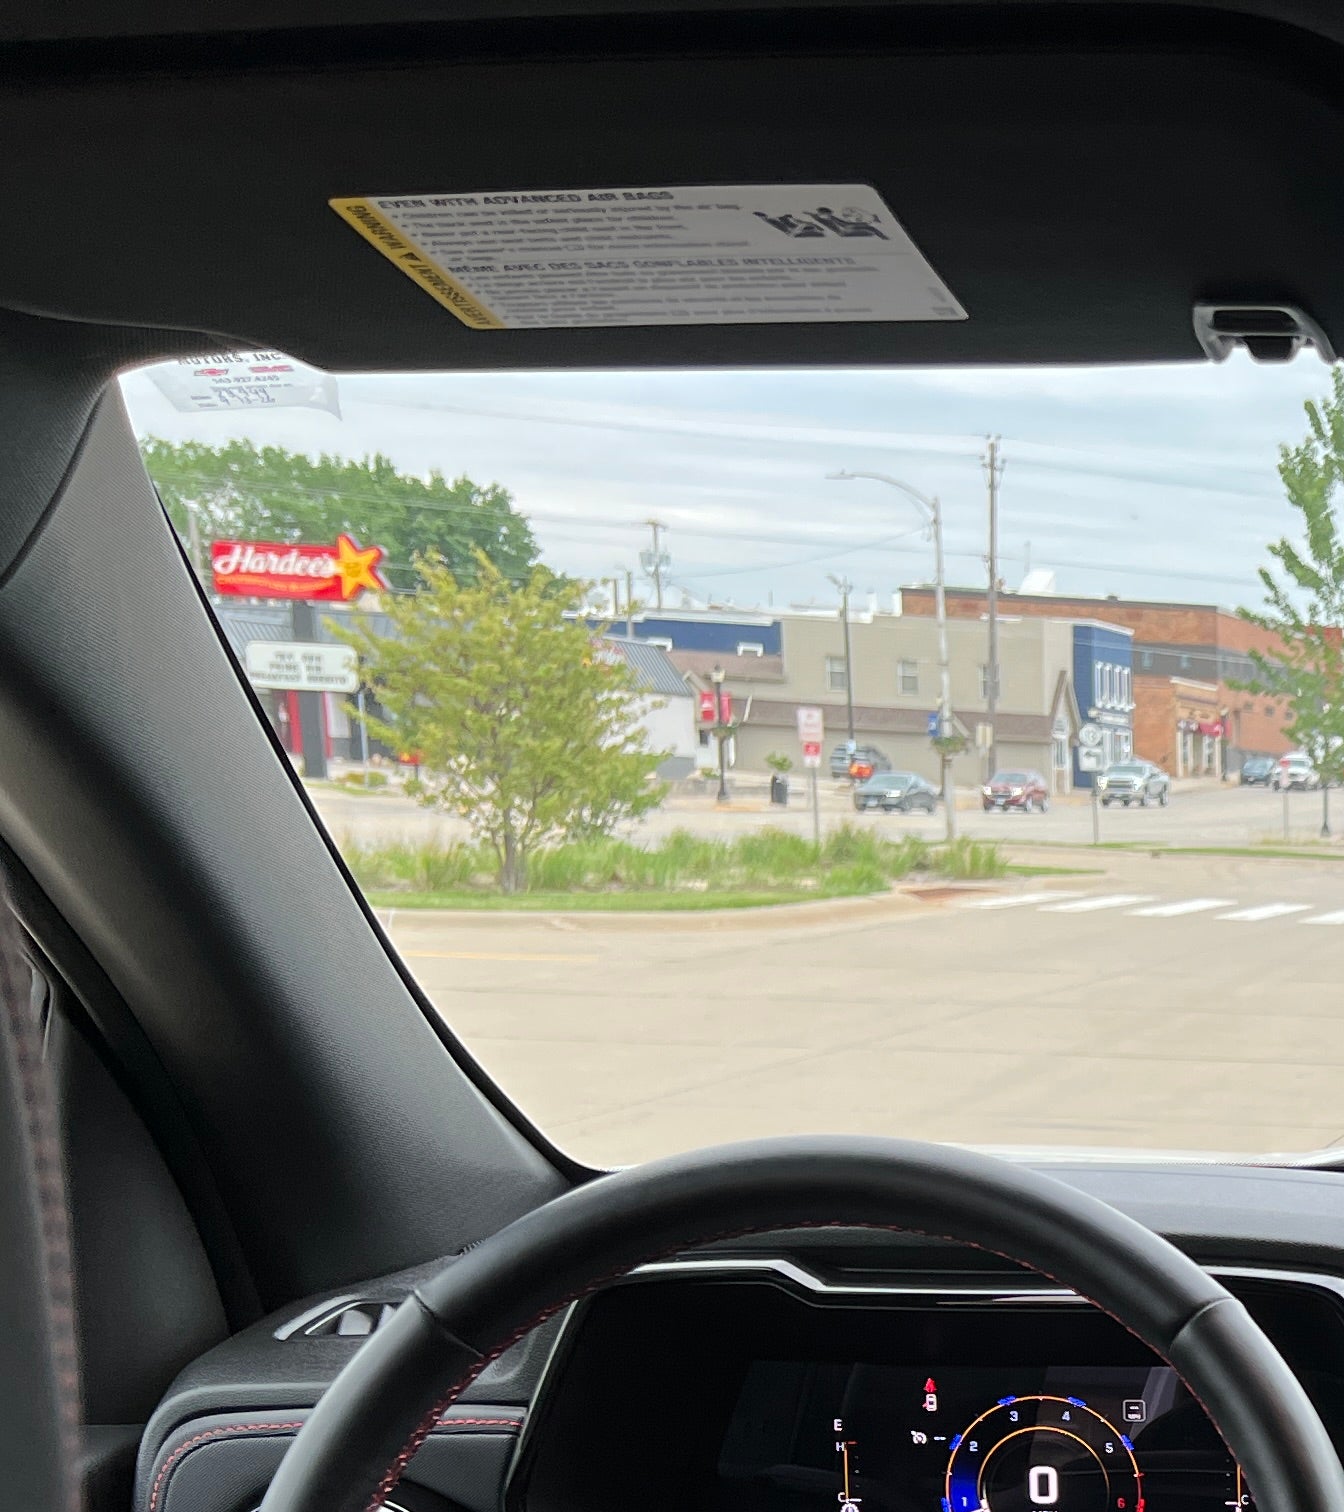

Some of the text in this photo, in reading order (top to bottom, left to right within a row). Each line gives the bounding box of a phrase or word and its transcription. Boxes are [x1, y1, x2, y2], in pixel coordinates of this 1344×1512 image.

[378, 190, 676, 210] EVEN WITH ADVANCED AIR BAGS
[212, 545, 338, 579] Hardee's
[1009, 1411, 1019, 1422] 3
[1061, 1411, 1071, 1422] 4
[833, 1419, 843, 1432] E
[836, 1441, 845, 1452] H
[970, 1441, 979, 1452] 2
[1105, 1442, 1114, 1454] 5
[1029, 1466, 1059, 1504] 0
[837, 1492, 846, 1503] C
[961, 1497, 968, 1507] 1
[1241, 1495, 1249, 1505] C
[1117, 1498, 1126, 1509] 6
